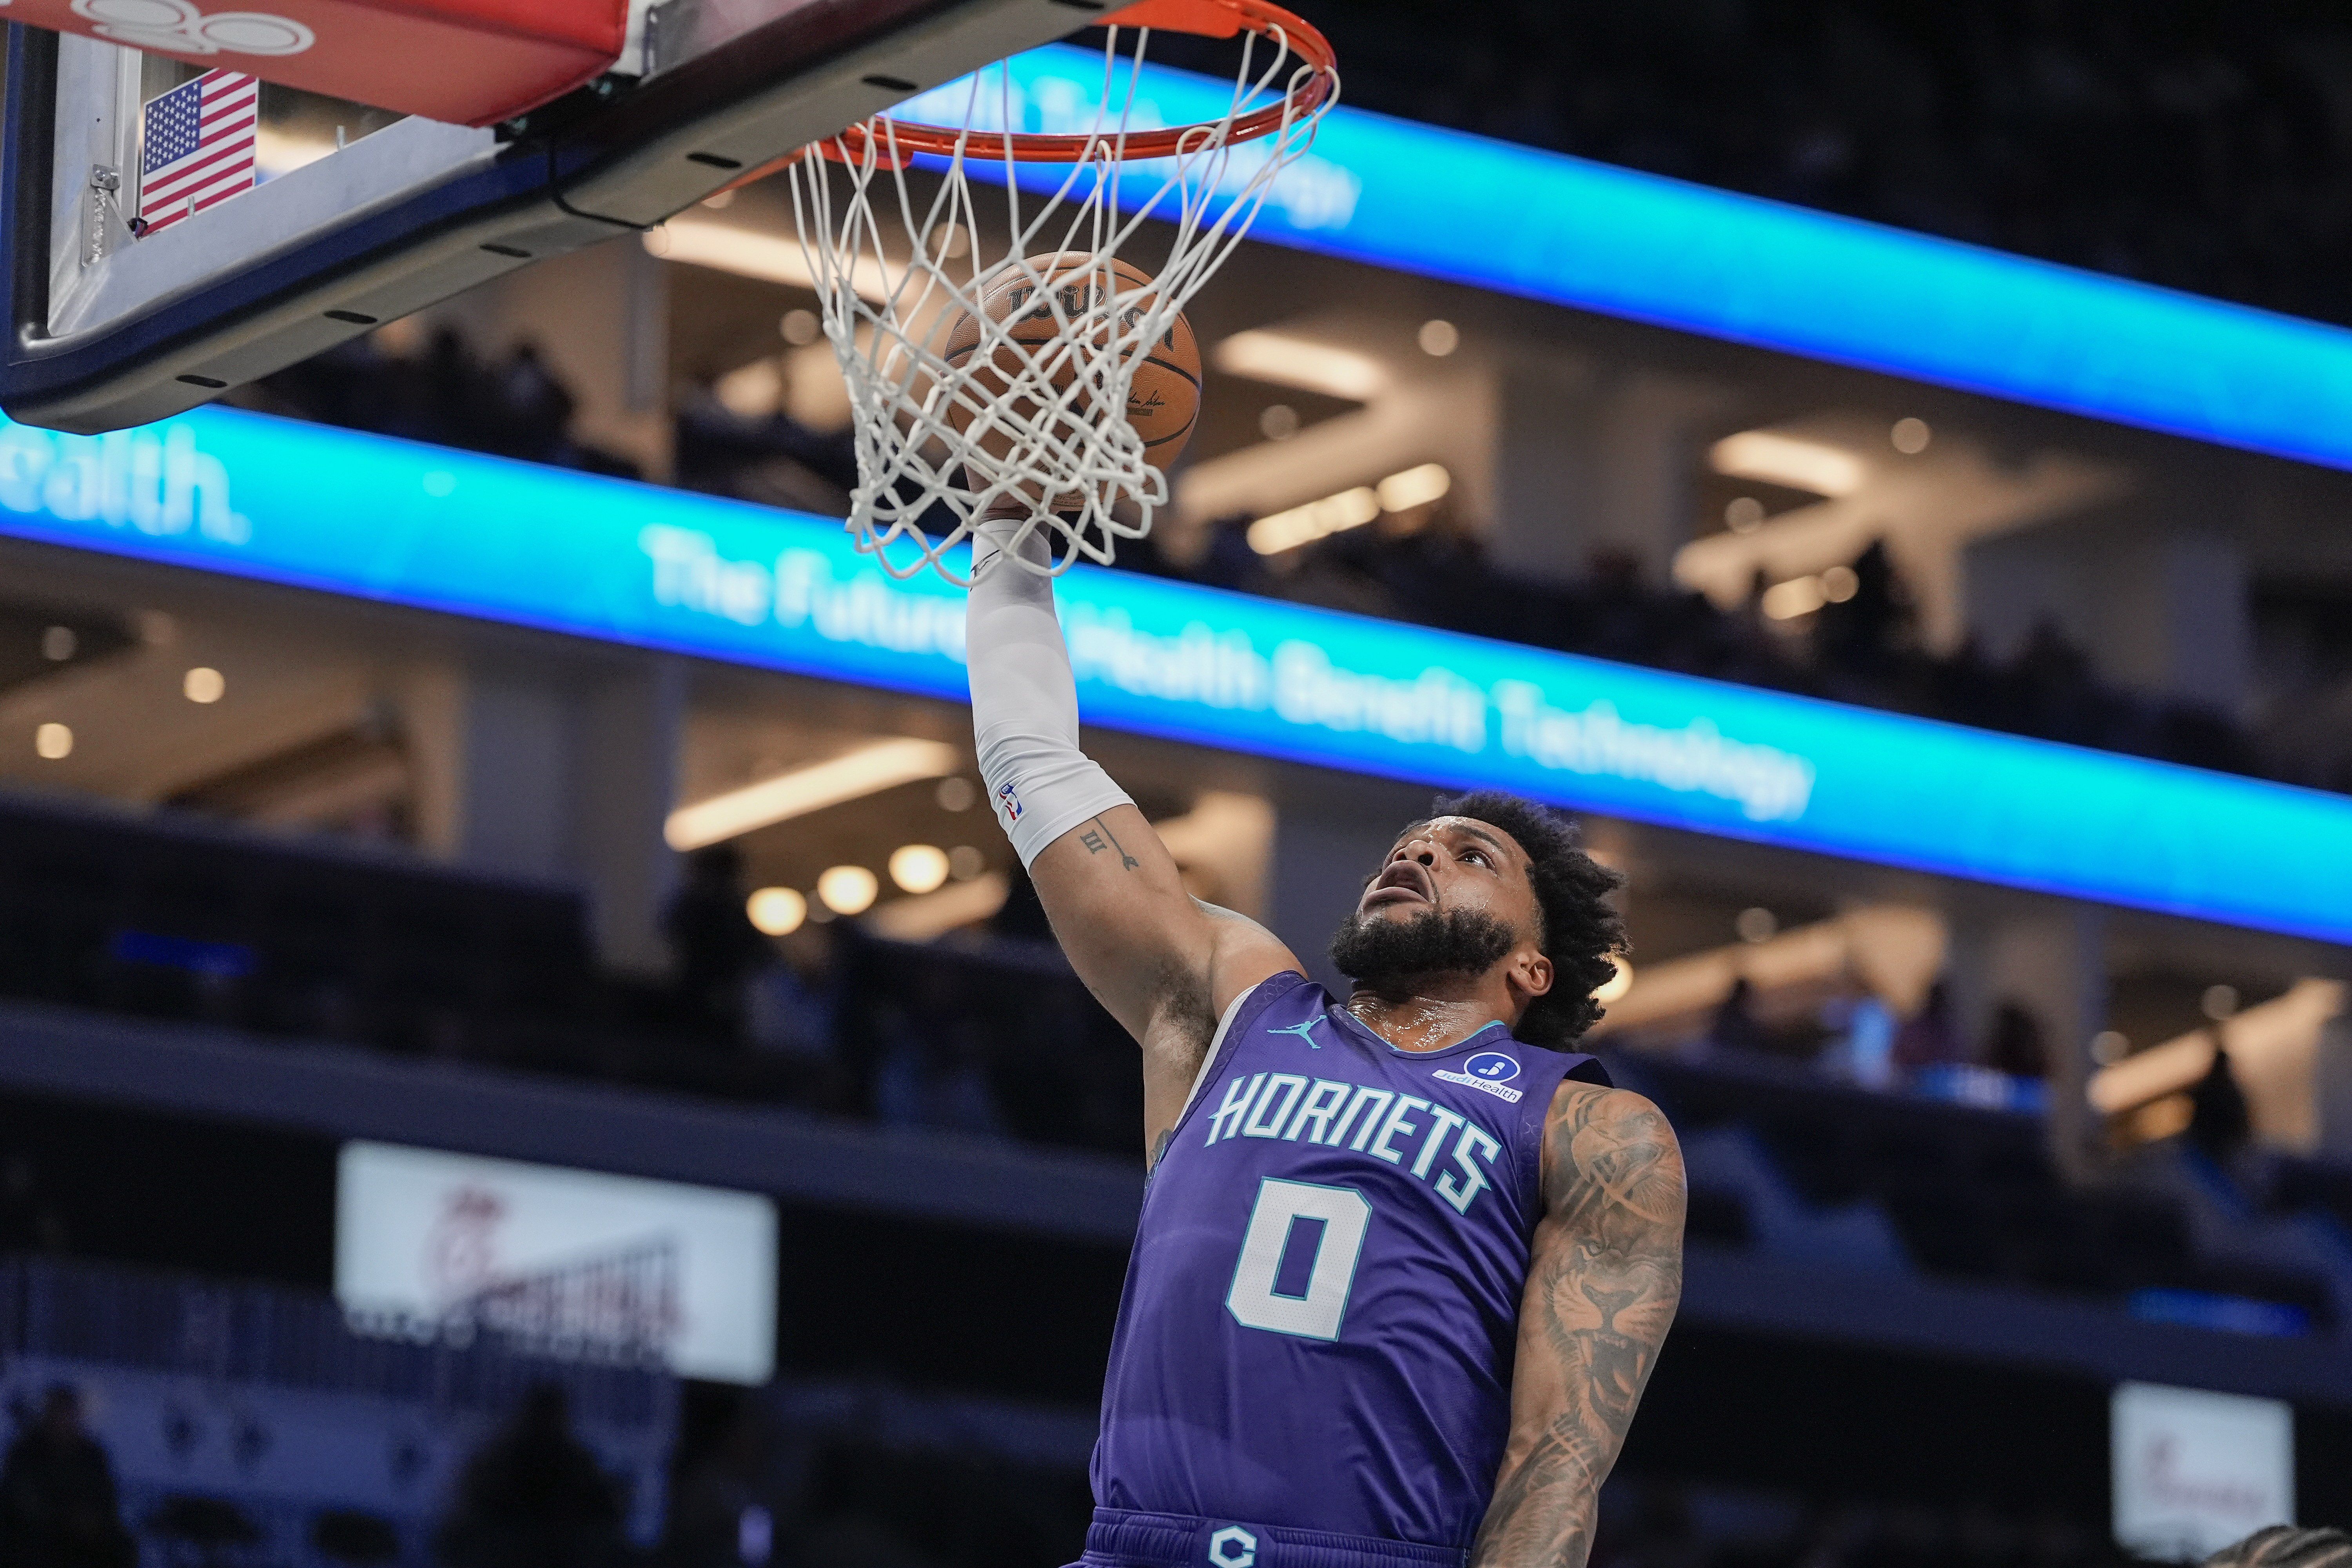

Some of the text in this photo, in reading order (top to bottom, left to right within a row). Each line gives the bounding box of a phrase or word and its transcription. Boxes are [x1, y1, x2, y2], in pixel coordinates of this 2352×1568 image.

[639, 524, 771, 626] The
[1272, 638, 1487, 753] Benefit
[1490, 678, 1816, 822] Technology
[1204, 1073, 1501, 1215] HORNETS
[1436, 1073, 1517, 1101] Judi Health
[1225, 1176, 1372, 1342] 0
